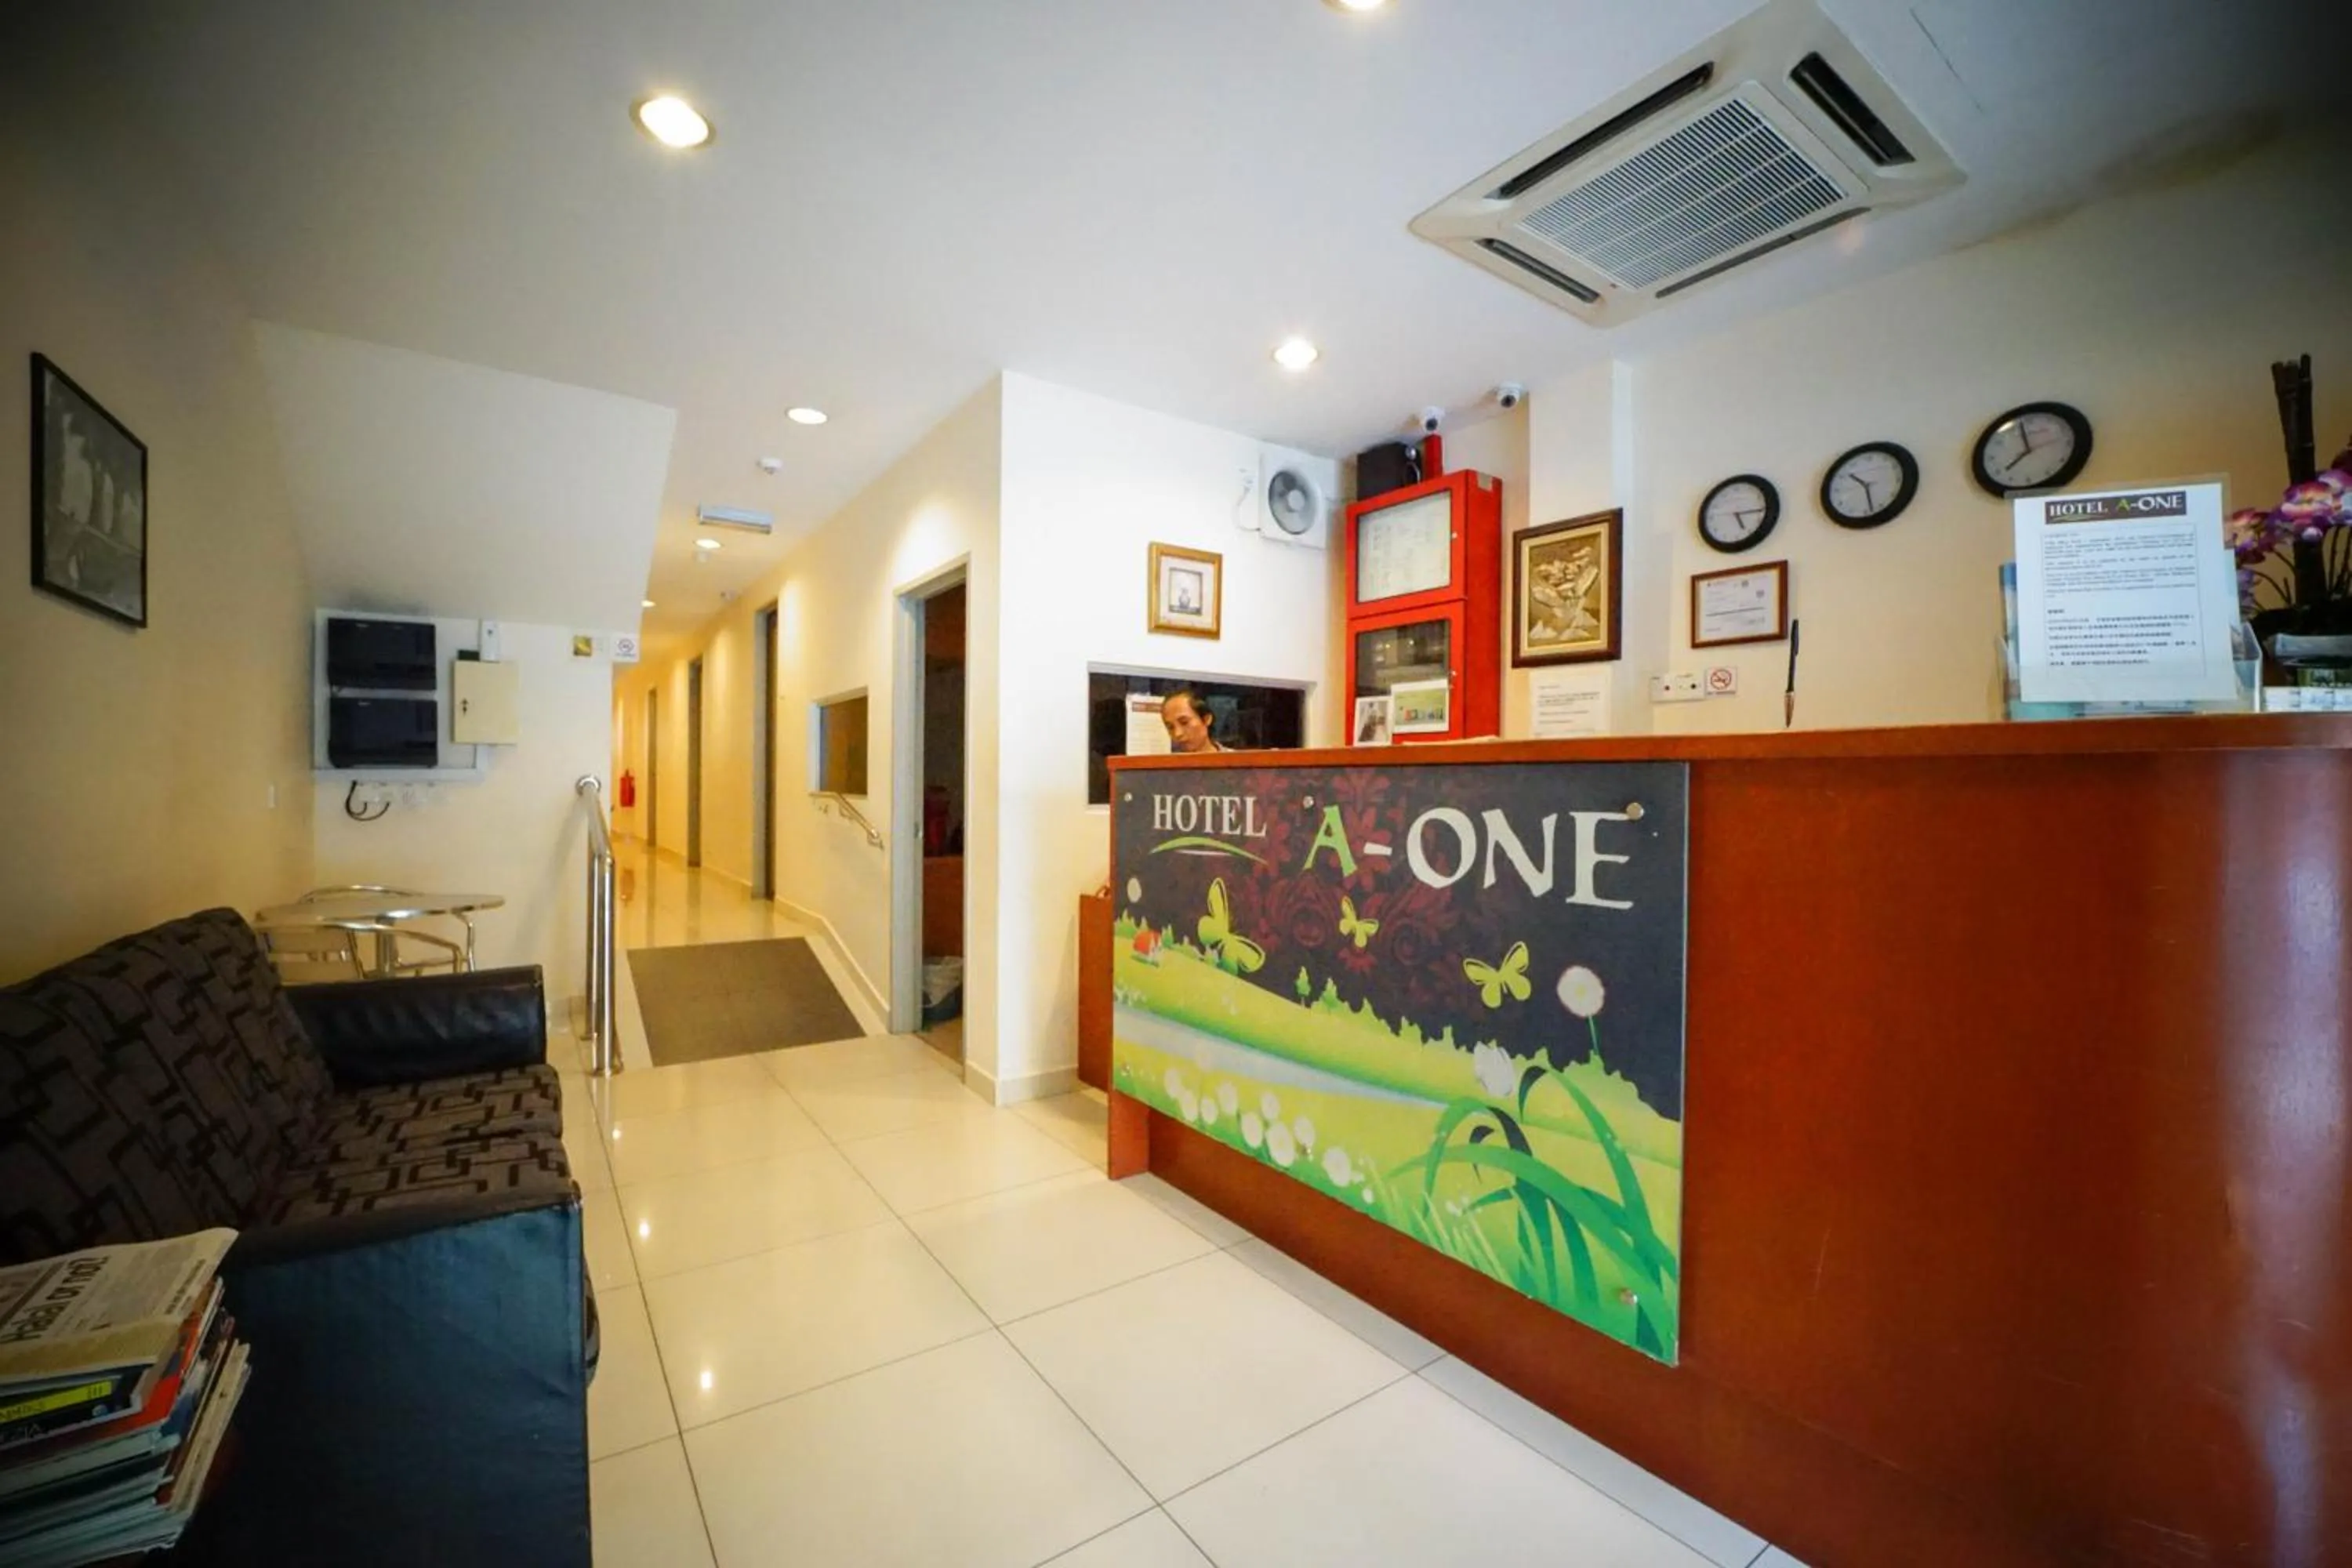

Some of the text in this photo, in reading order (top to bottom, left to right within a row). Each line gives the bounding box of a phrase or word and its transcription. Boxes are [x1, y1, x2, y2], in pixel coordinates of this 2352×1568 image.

[2049, 494, 2183, 517] HOTEL A-ONE
[1152, 793, 1635, 910] HOTEL A-ONE
